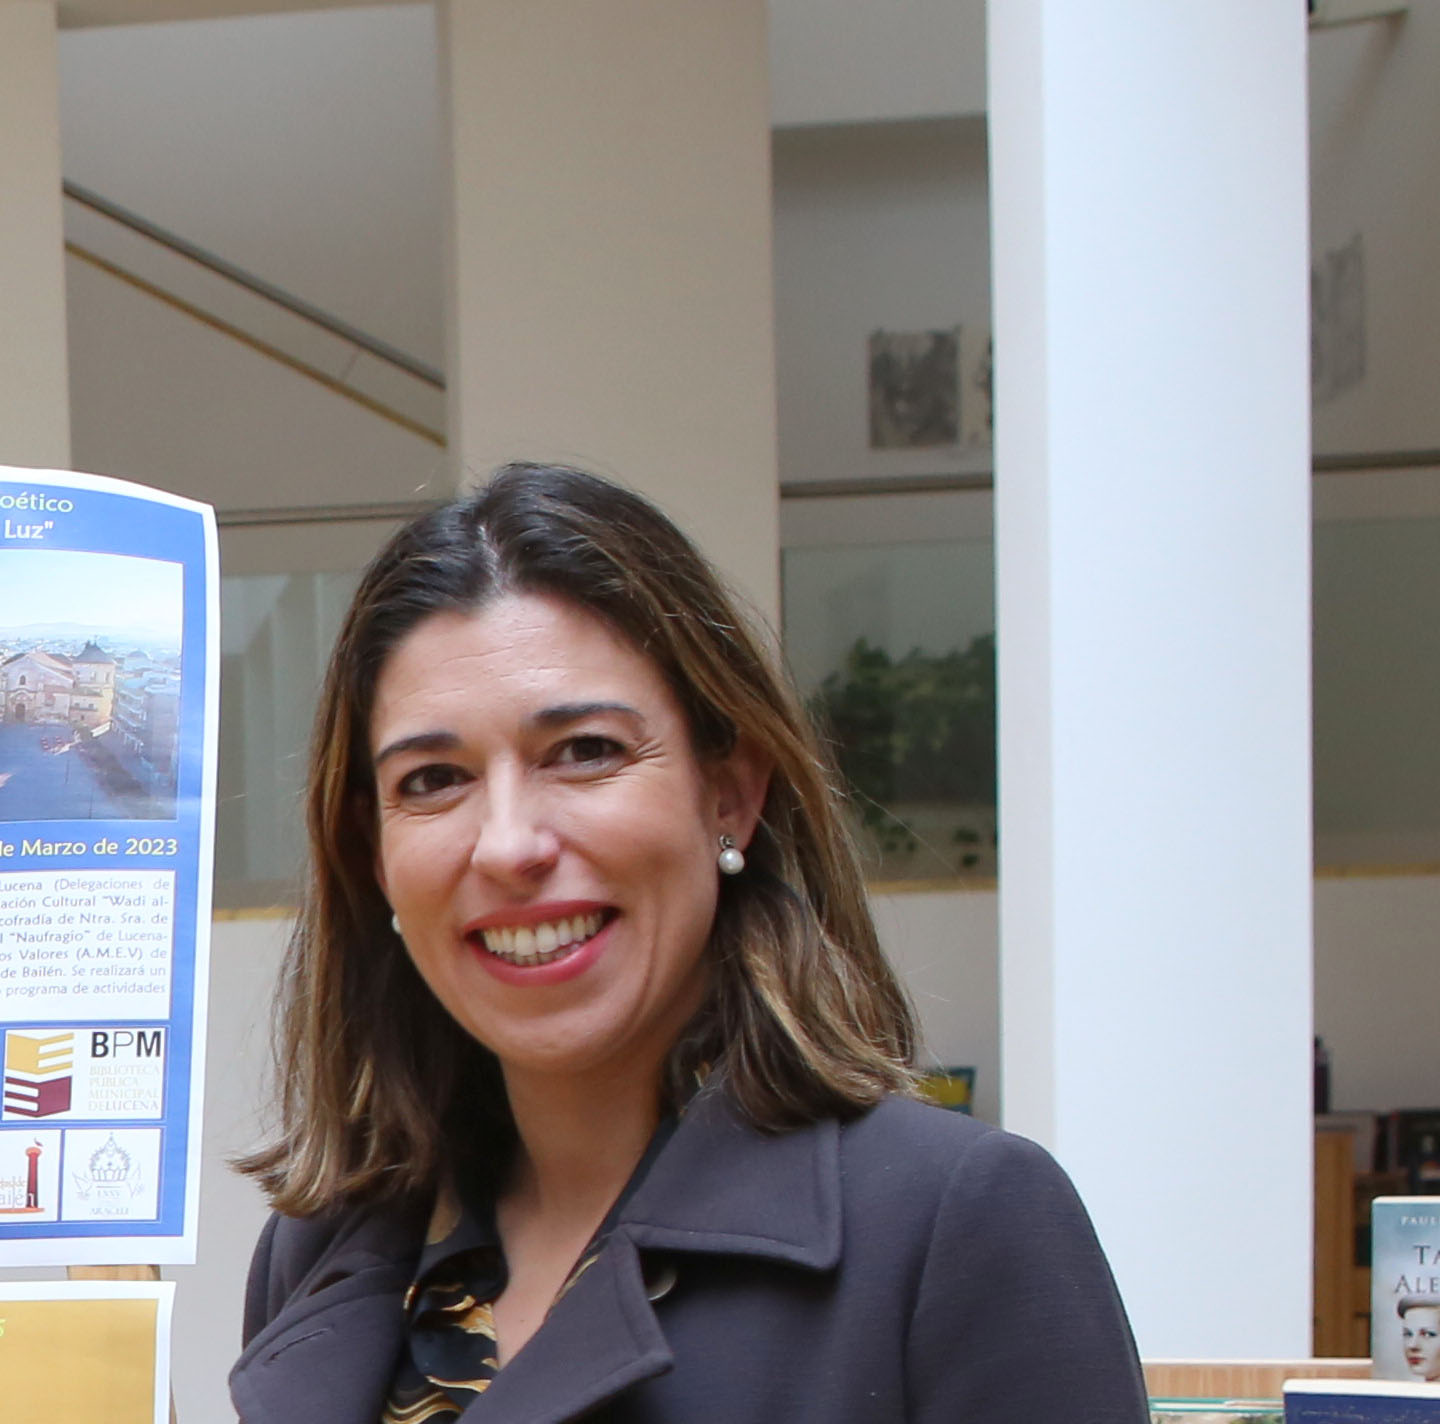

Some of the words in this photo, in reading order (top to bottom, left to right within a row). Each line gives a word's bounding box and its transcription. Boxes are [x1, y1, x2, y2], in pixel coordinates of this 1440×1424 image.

[4, 520, 54, 540] Luz"
[21, 839, 86, 857] Marzo
[93, 837, 118, 855] de
[125, 838, 177, 856] 2023
[91, 1031, 161, 1058] BPM
[89, 1065, 160, 1076] BIBLIOTECA
[88, 1088, 159, 1099] MUNICIPAL
